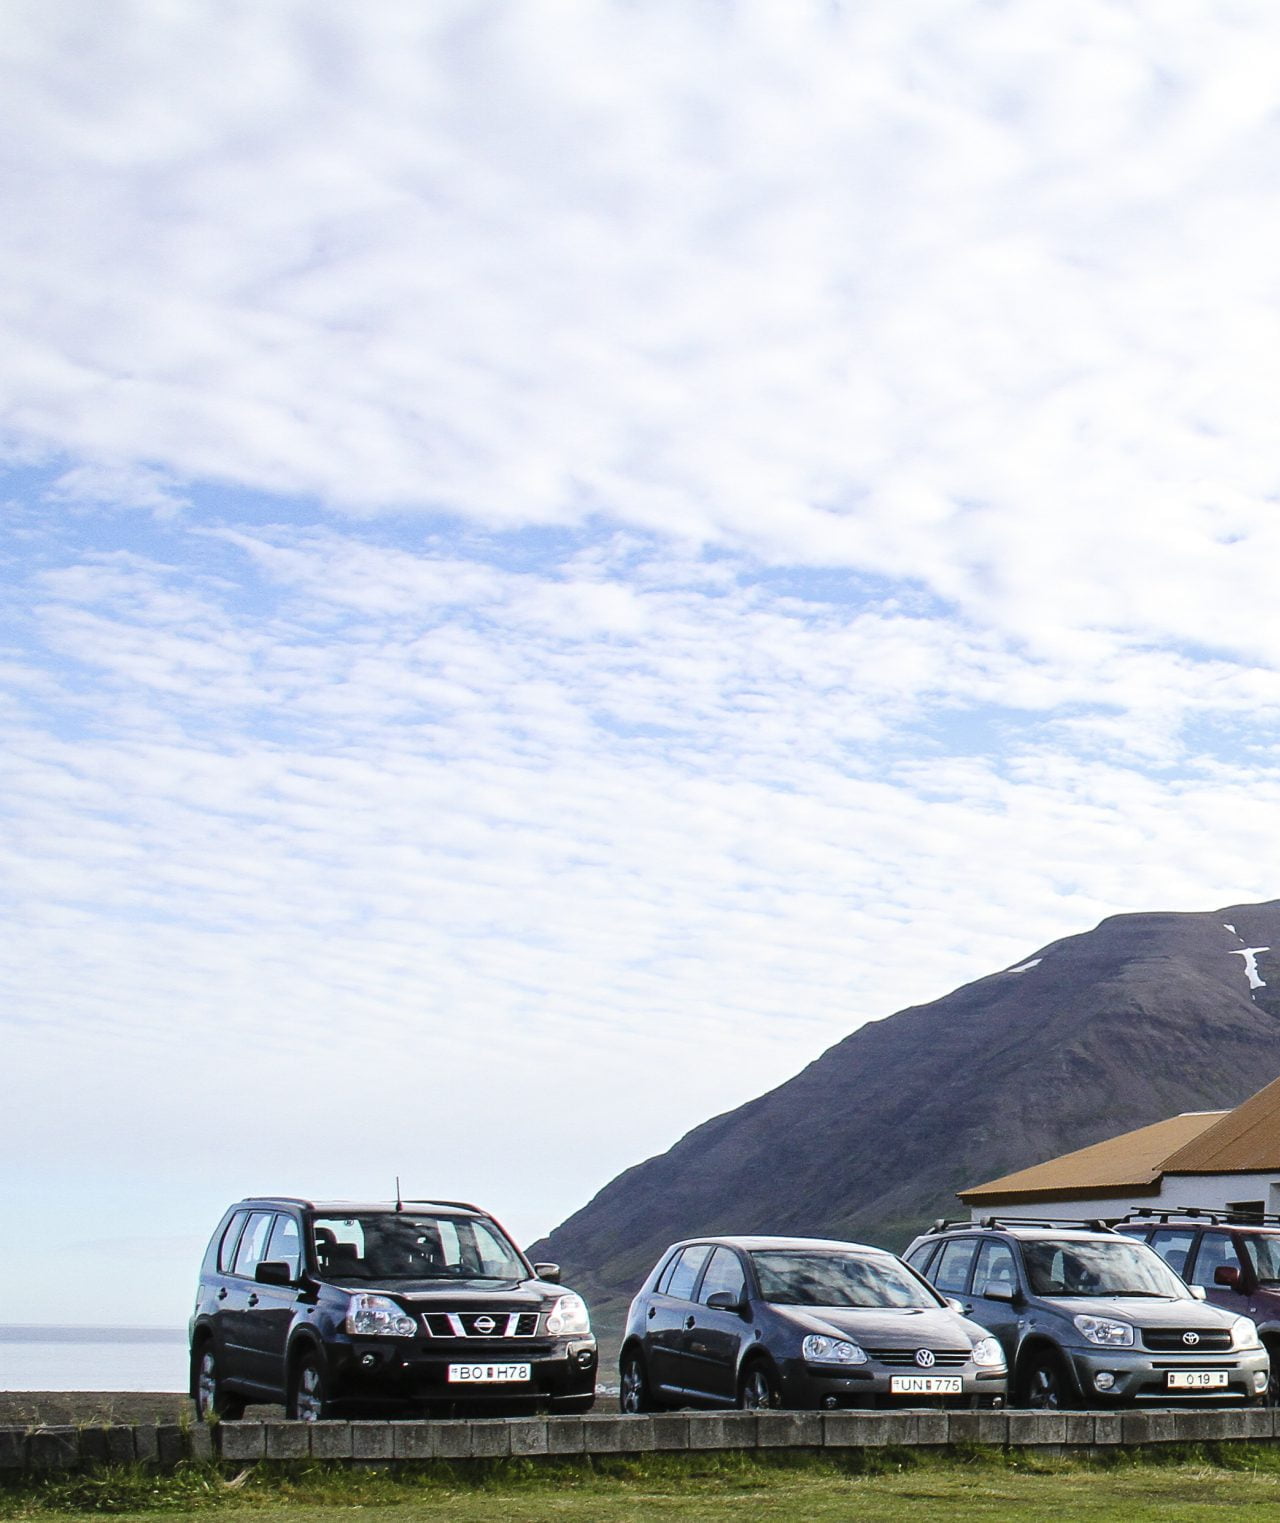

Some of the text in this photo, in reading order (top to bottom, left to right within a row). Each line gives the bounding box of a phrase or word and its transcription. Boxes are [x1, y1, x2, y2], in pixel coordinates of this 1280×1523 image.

[497, 1366, 528, 1379] H78
[901, 1379, 960, 1391] UN 775
[1198, 1373, 1210, 1385] 19
